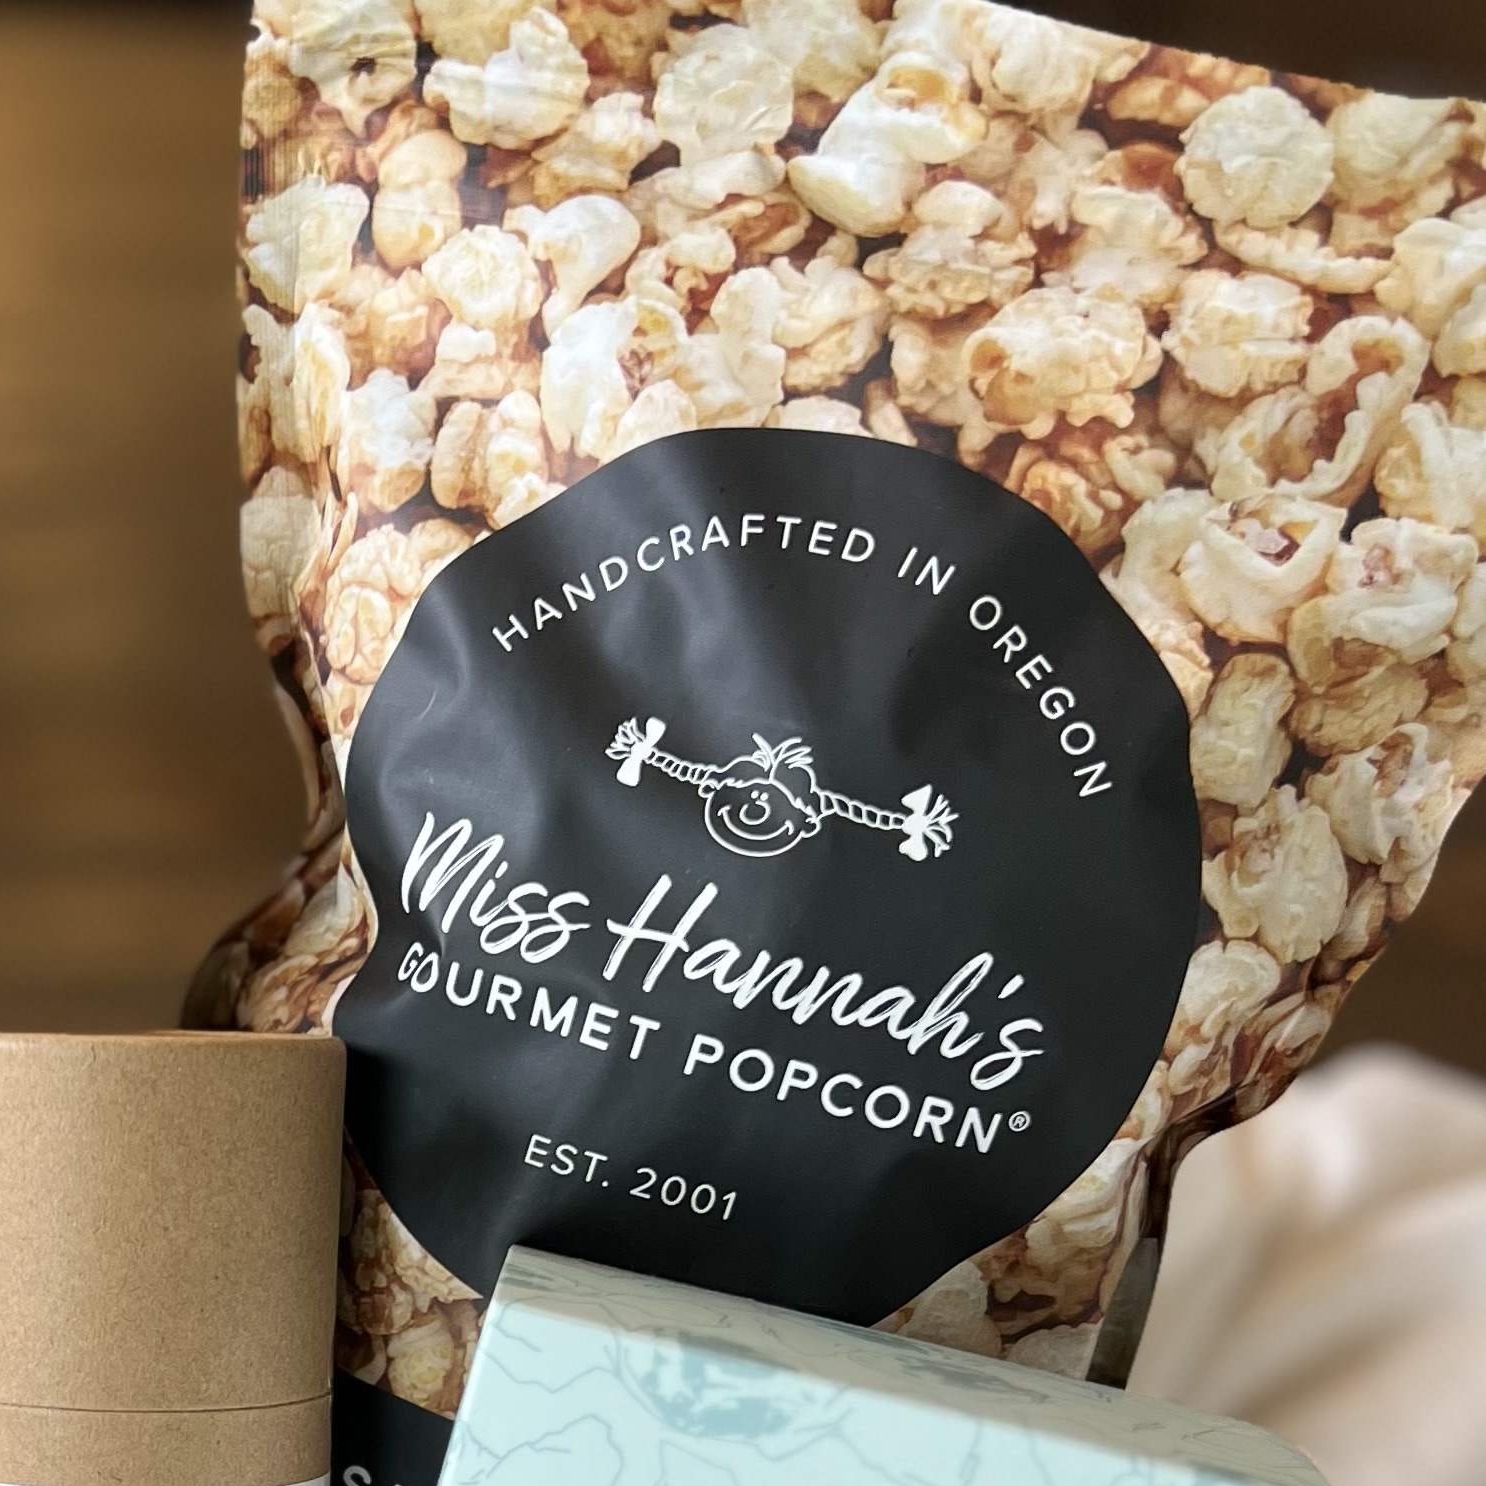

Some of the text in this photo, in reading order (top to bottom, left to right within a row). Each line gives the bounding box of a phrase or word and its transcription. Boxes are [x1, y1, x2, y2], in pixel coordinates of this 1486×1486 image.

[492, 514, 1113, 798] HANDCRAFTED IN OREGON
[398, 942, 661, 1059] GOURMET
[401, 811, 1045, 1090] Miss Hannah's
[524, 1134, 737, 1220] EST. 2001
